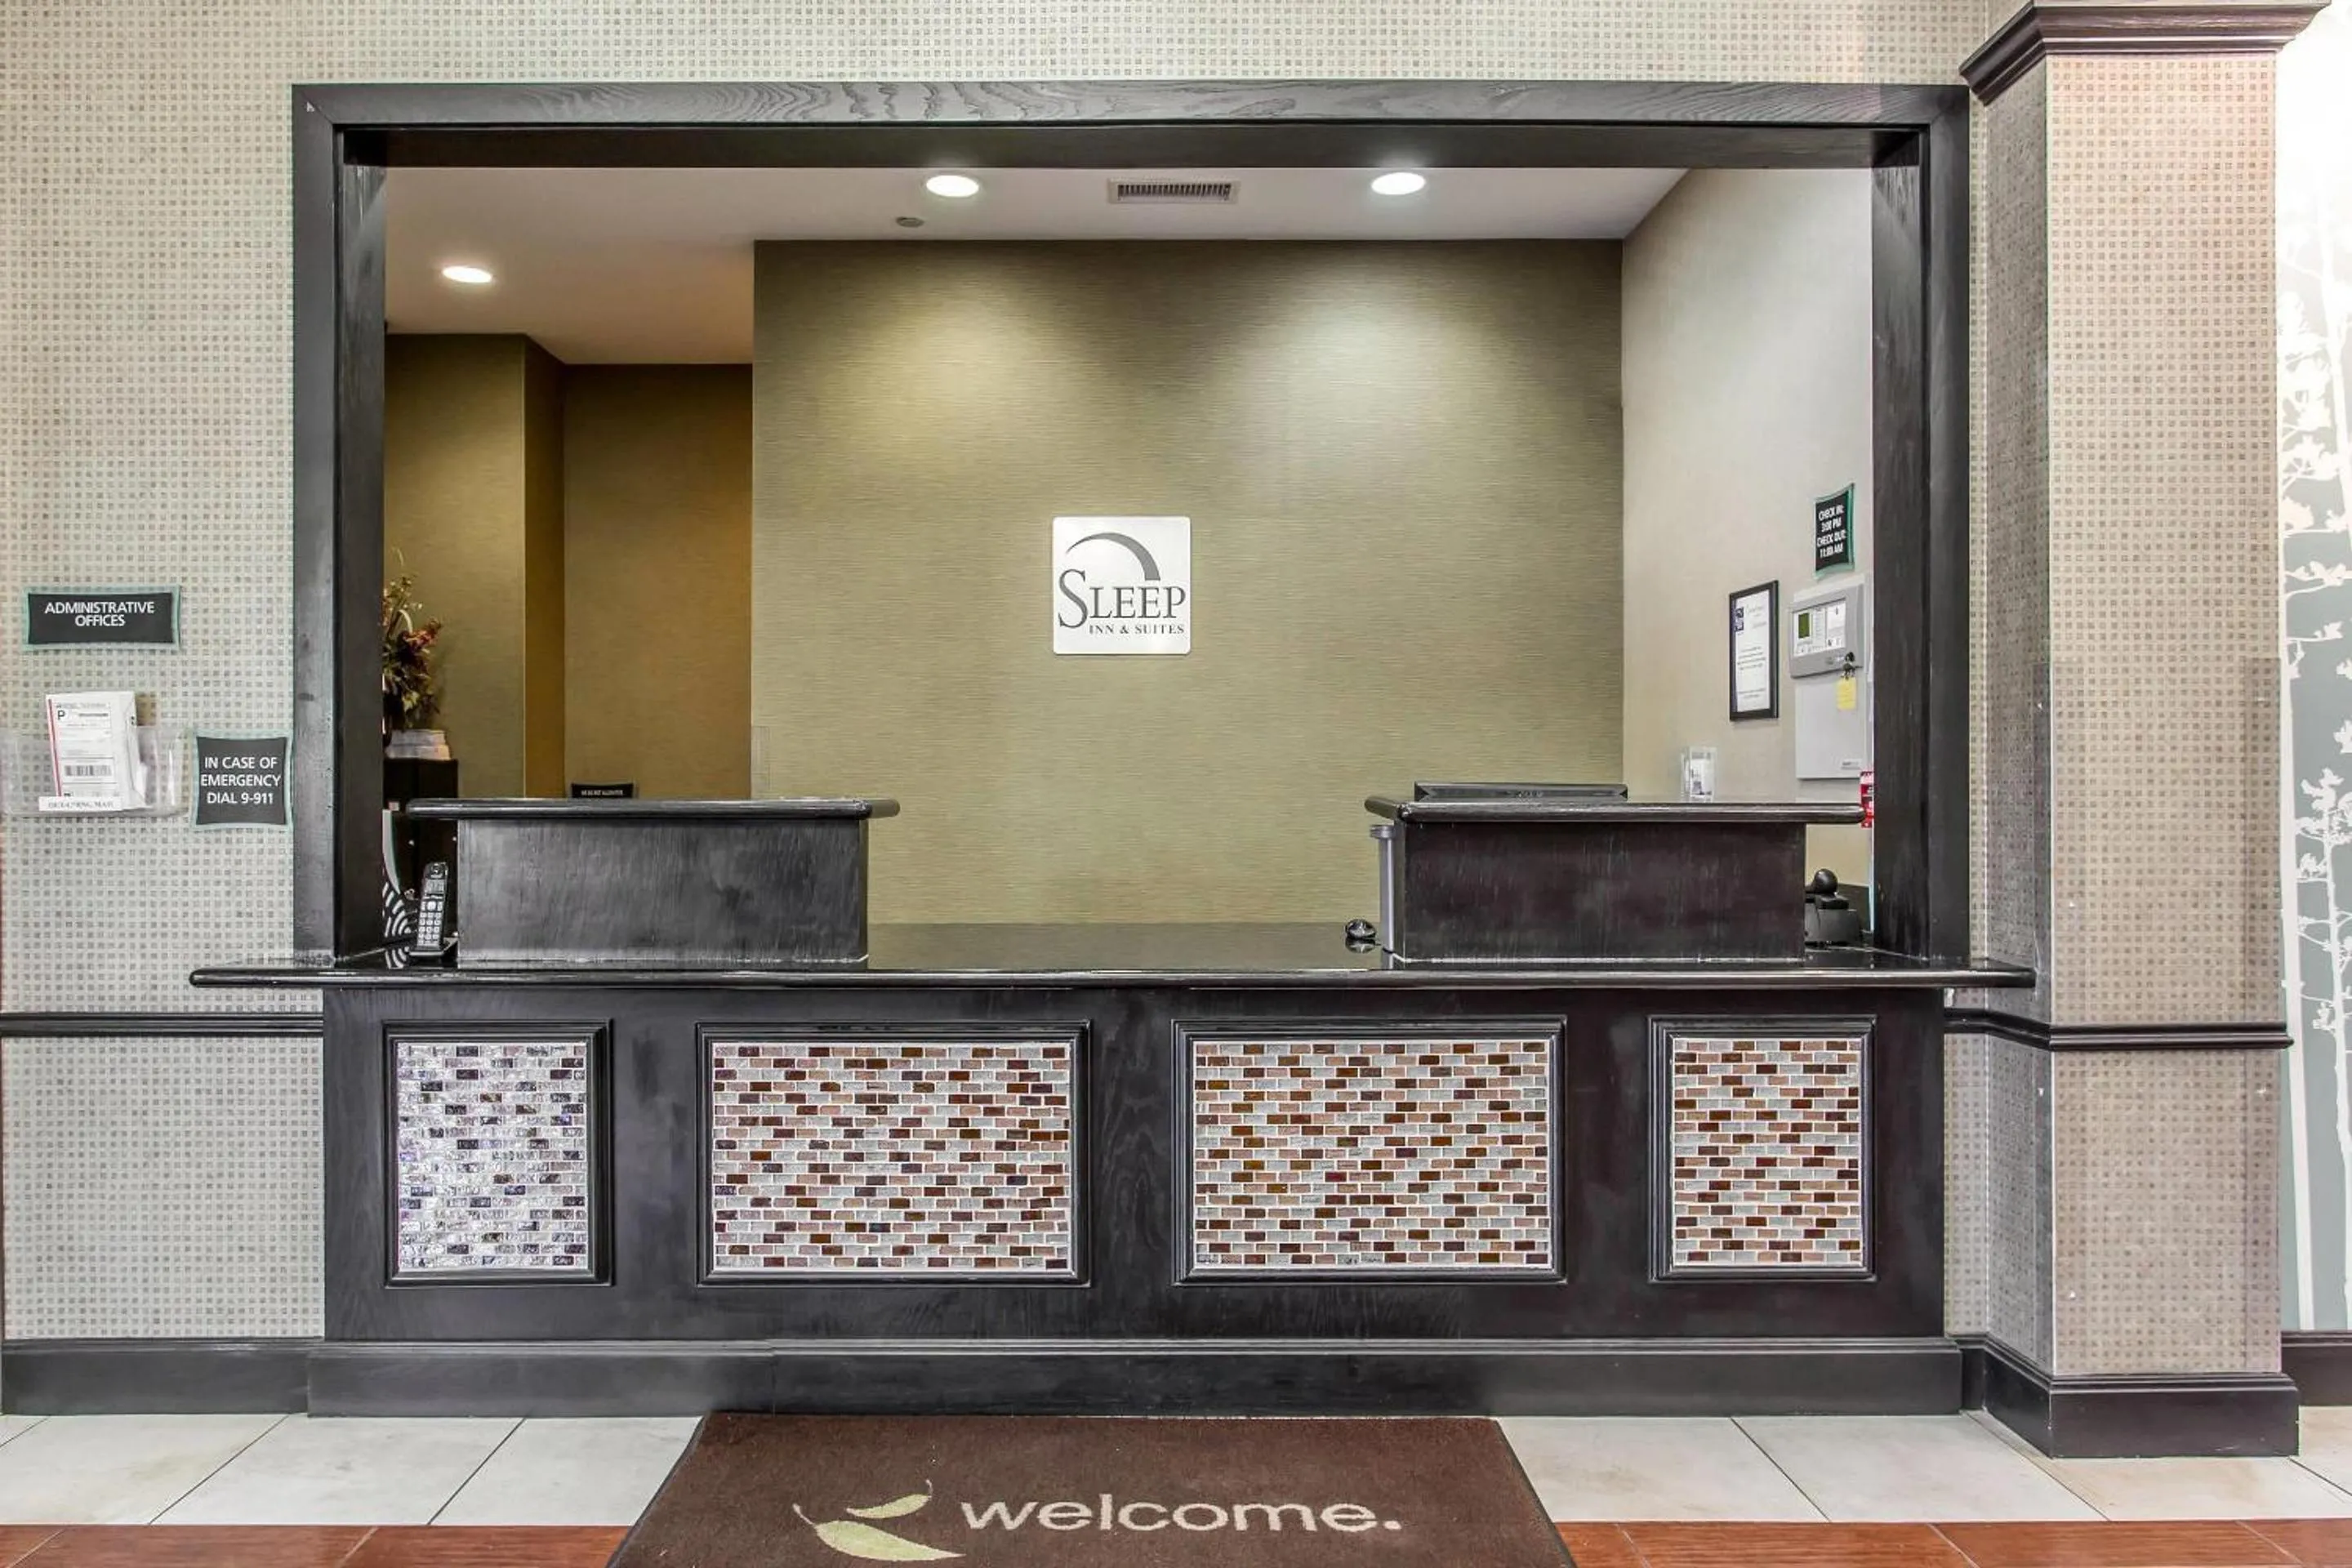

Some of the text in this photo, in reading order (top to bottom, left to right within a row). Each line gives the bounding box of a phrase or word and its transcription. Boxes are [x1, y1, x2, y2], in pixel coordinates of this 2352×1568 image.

[1818, 506, 1835, 521] CHECK
[1817, 533, 1833, 547] CHECK
[1058, 569, 1186, 628] SLEEP
[45, 601, 155, 614] ADMINISTRATIVE
[74, 614, 126, 626] OFFICES
[1089, 624, 1184, 635] INN & SUITES
[204, 756, 278, 769] IN CASE OF
[200, 773, 282, 787] EMERGENCY
[207, 791, 274, 805] DIAL 9-911
[960, 1493, 1402, 1532] welcome.
